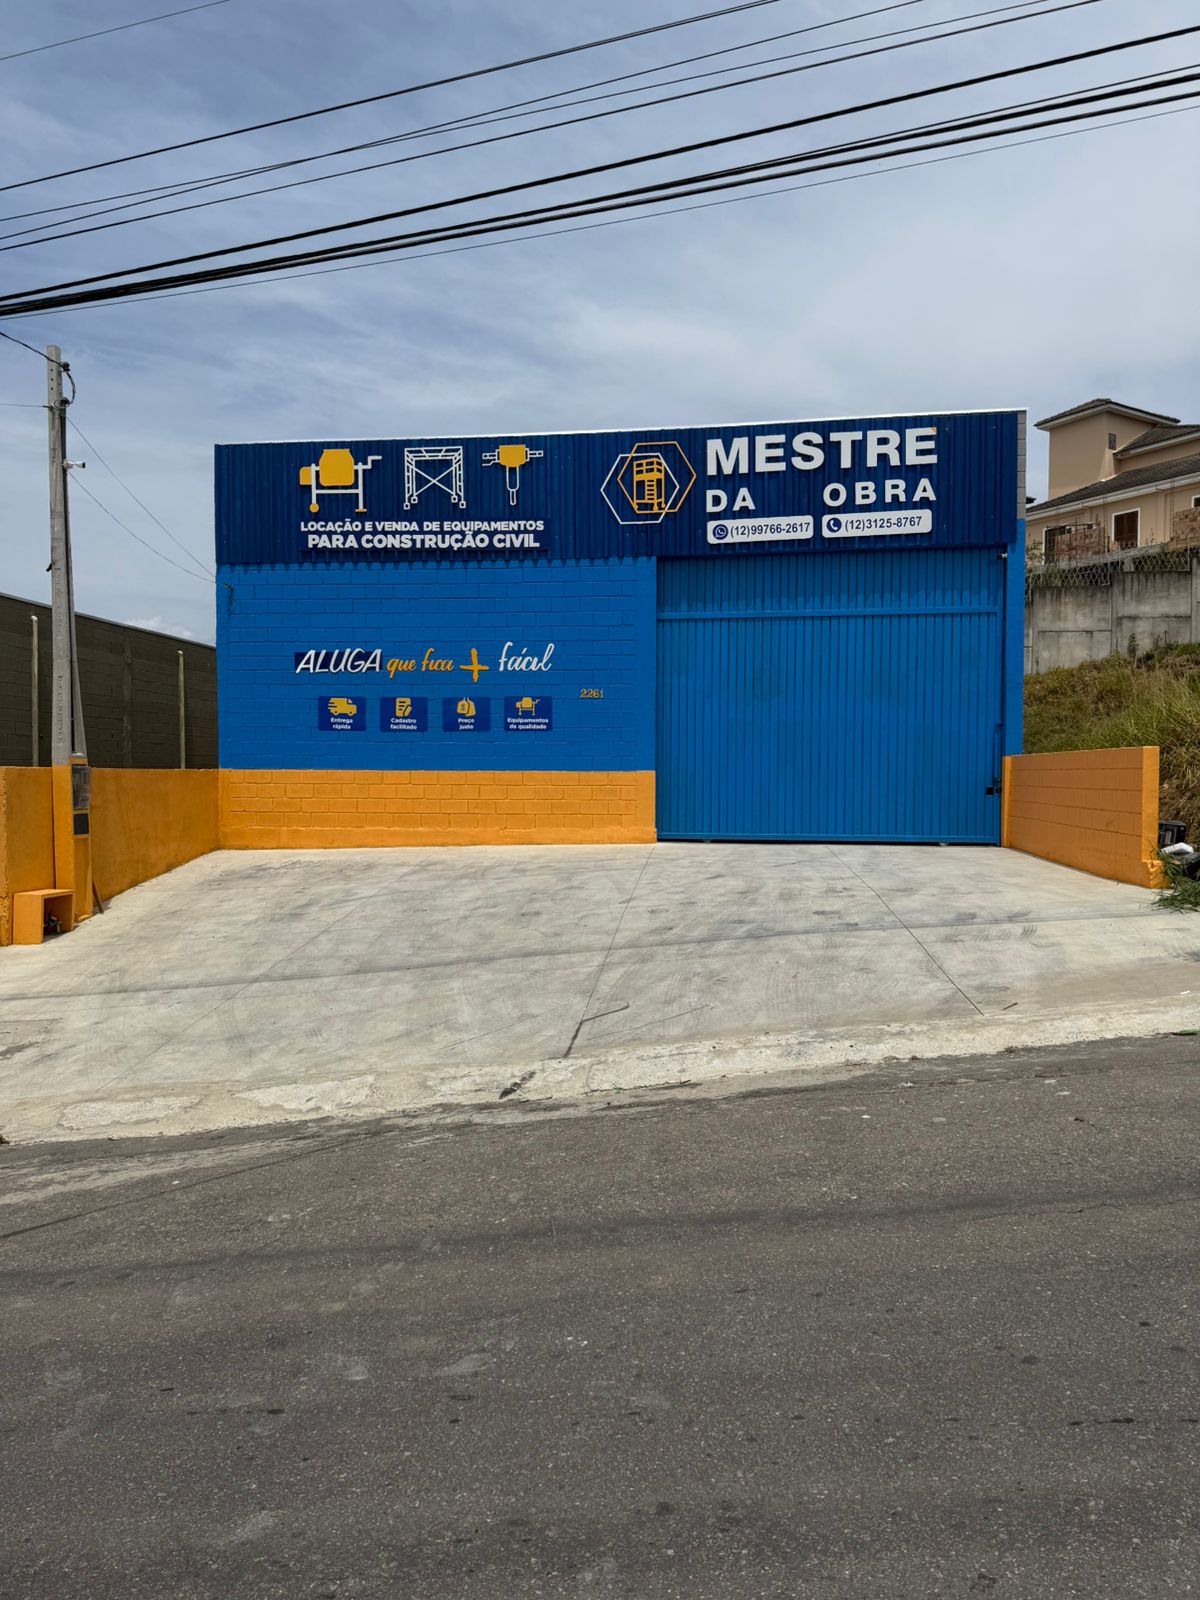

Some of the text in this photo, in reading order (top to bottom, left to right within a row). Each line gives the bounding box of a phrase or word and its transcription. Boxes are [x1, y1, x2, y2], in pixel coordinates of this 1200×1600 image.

[706, 427, 938, 476] MESTRE
[706, 477, 937, 513] DA OBRA
[300, 518, 545, 533] LOCAÇÃO E VENDA DE EQUIPAMENTOS
[845, 516, 922, 532] (12)3125-8767
[730, 522, 810, 538] (12)99766-2617
[307, 531, 540, 551] PARA CONSTRUÇÃO CIVIL
[296, 648, 382, 673] ALUGA
[386, 658, 417, 679] que
[420, 647, 454, 672] fica
[498, 641, 555, 672] fácil
[579, 689, 604, 699] 2261
[330, 717, 353, 725] Entrega
[390, 717, 417, 725] Cadastro
[457, 717, 475, 725] Preço
[507, 717, 549, 725] Equipamentos
[332, 723, 352, 731] rápida
[390, 723, 418, 731] facilitado
[459, 723, 474, 731] justo
[518, 723, 547, 731] qualidade
